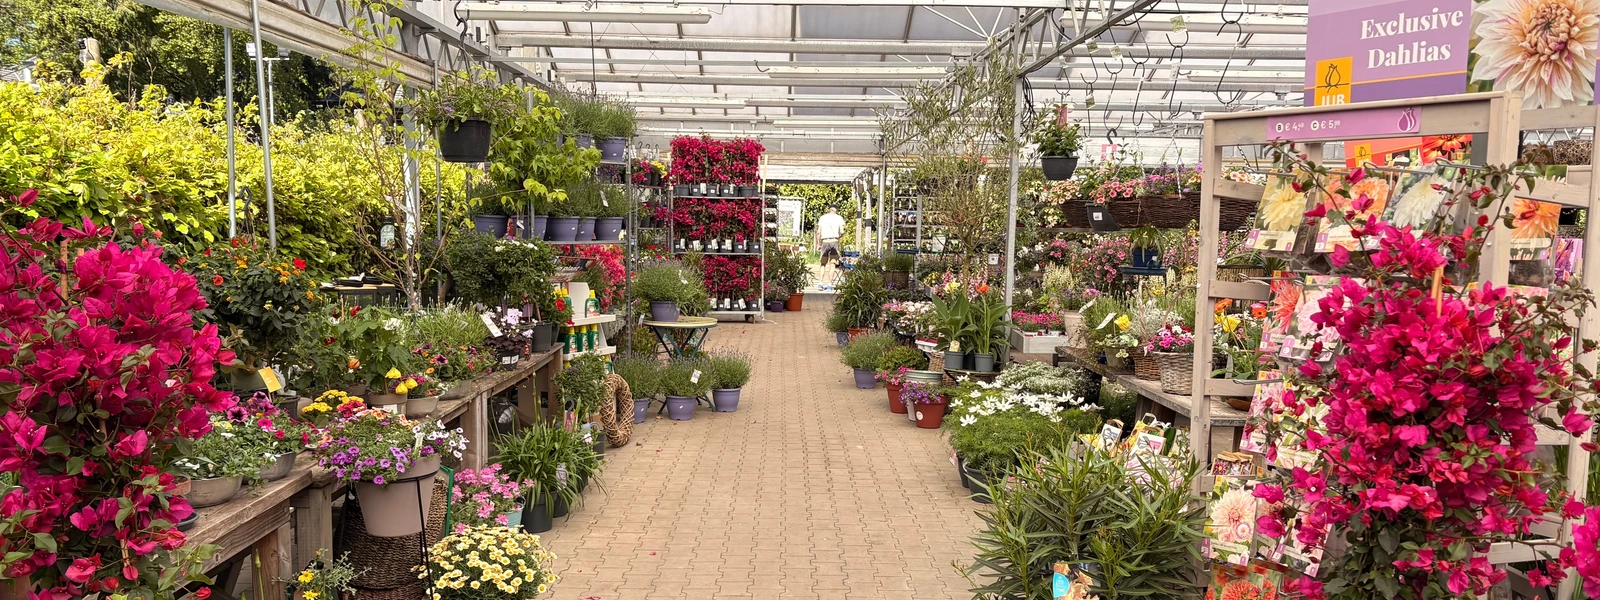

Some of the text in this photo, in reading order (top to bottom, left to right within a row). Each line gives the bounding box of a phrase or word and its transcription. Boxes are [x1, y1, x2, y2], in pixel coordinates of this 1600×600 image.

[1360, 7, 1464, 40] Exclusive
[1367, 41, 1451, 69] Dahlias
[1285, 122, 1290, 131] €
[1321, 120, 1326, 129] €
